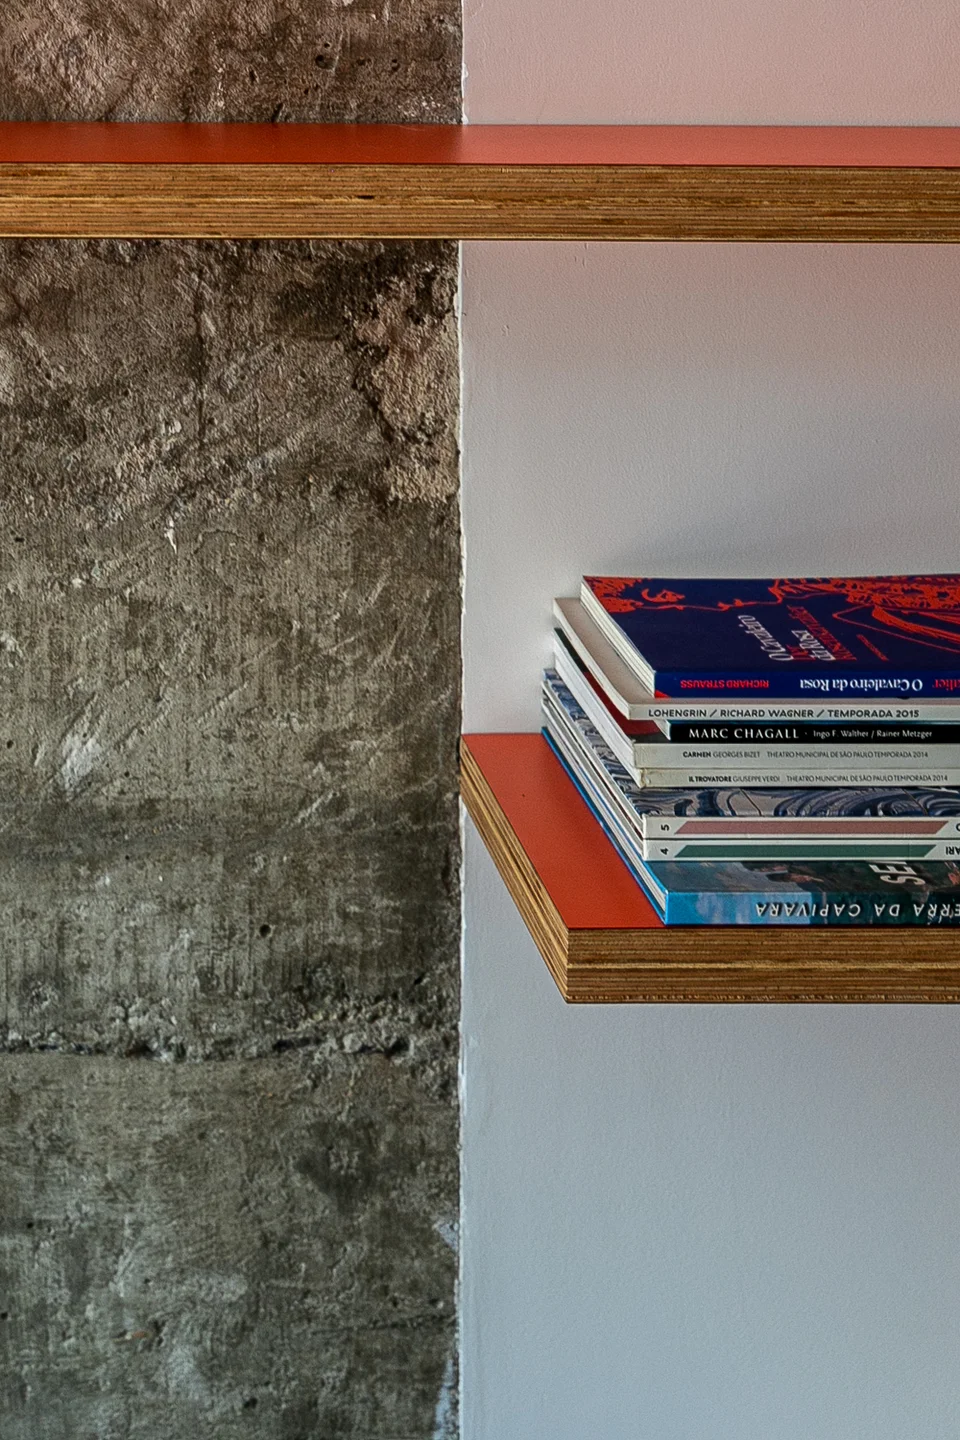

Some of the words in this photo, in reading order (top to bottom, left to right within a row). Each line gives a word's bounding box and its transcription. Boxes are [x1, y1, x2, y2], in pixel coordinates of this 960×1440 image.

[738, 615, 786, 652] Cavaleiro
[680, 679, 725, 689] STRAUSS
[726, 679, 769, 689] RICHARD
[800, 679, 829, 692] Rosa
[832, 679, 848, 692] da
[850, 679, 910, 692] Cavaleiro
[911, 679, 923, 692] O
[648, 709, 707, 718] LOHENGRIN
[709, 709, 718, 718] /
[720, 709, 765, 718] RICHARD
[768, 709, 814, 718] WAGNER
[816, 709, 825, 718] /
[827, 709, 893, 718] TEMPORADA
[896, 709, 919, 718] 2015
[689, 728, 729, 739] MARC
[734, 728, 799, 739] CHAGALL
[813, 730, 830, 740] Ingo
[832, 730, 839, 738] F.
[841, 730, 869, 738] Walther
[876, 730, 900, 738] Rainer
[902, 730, 933, 740] Metzger
[839, 750, 852, 758] SÃO
[859, 774, 872, 782] SÃO
[660, 847, 669, 855] 4
[866, 860, 926, 885] SE
[755, 903, 861, 917] CAPIVARA
[874, 903, 900, 917] DA
